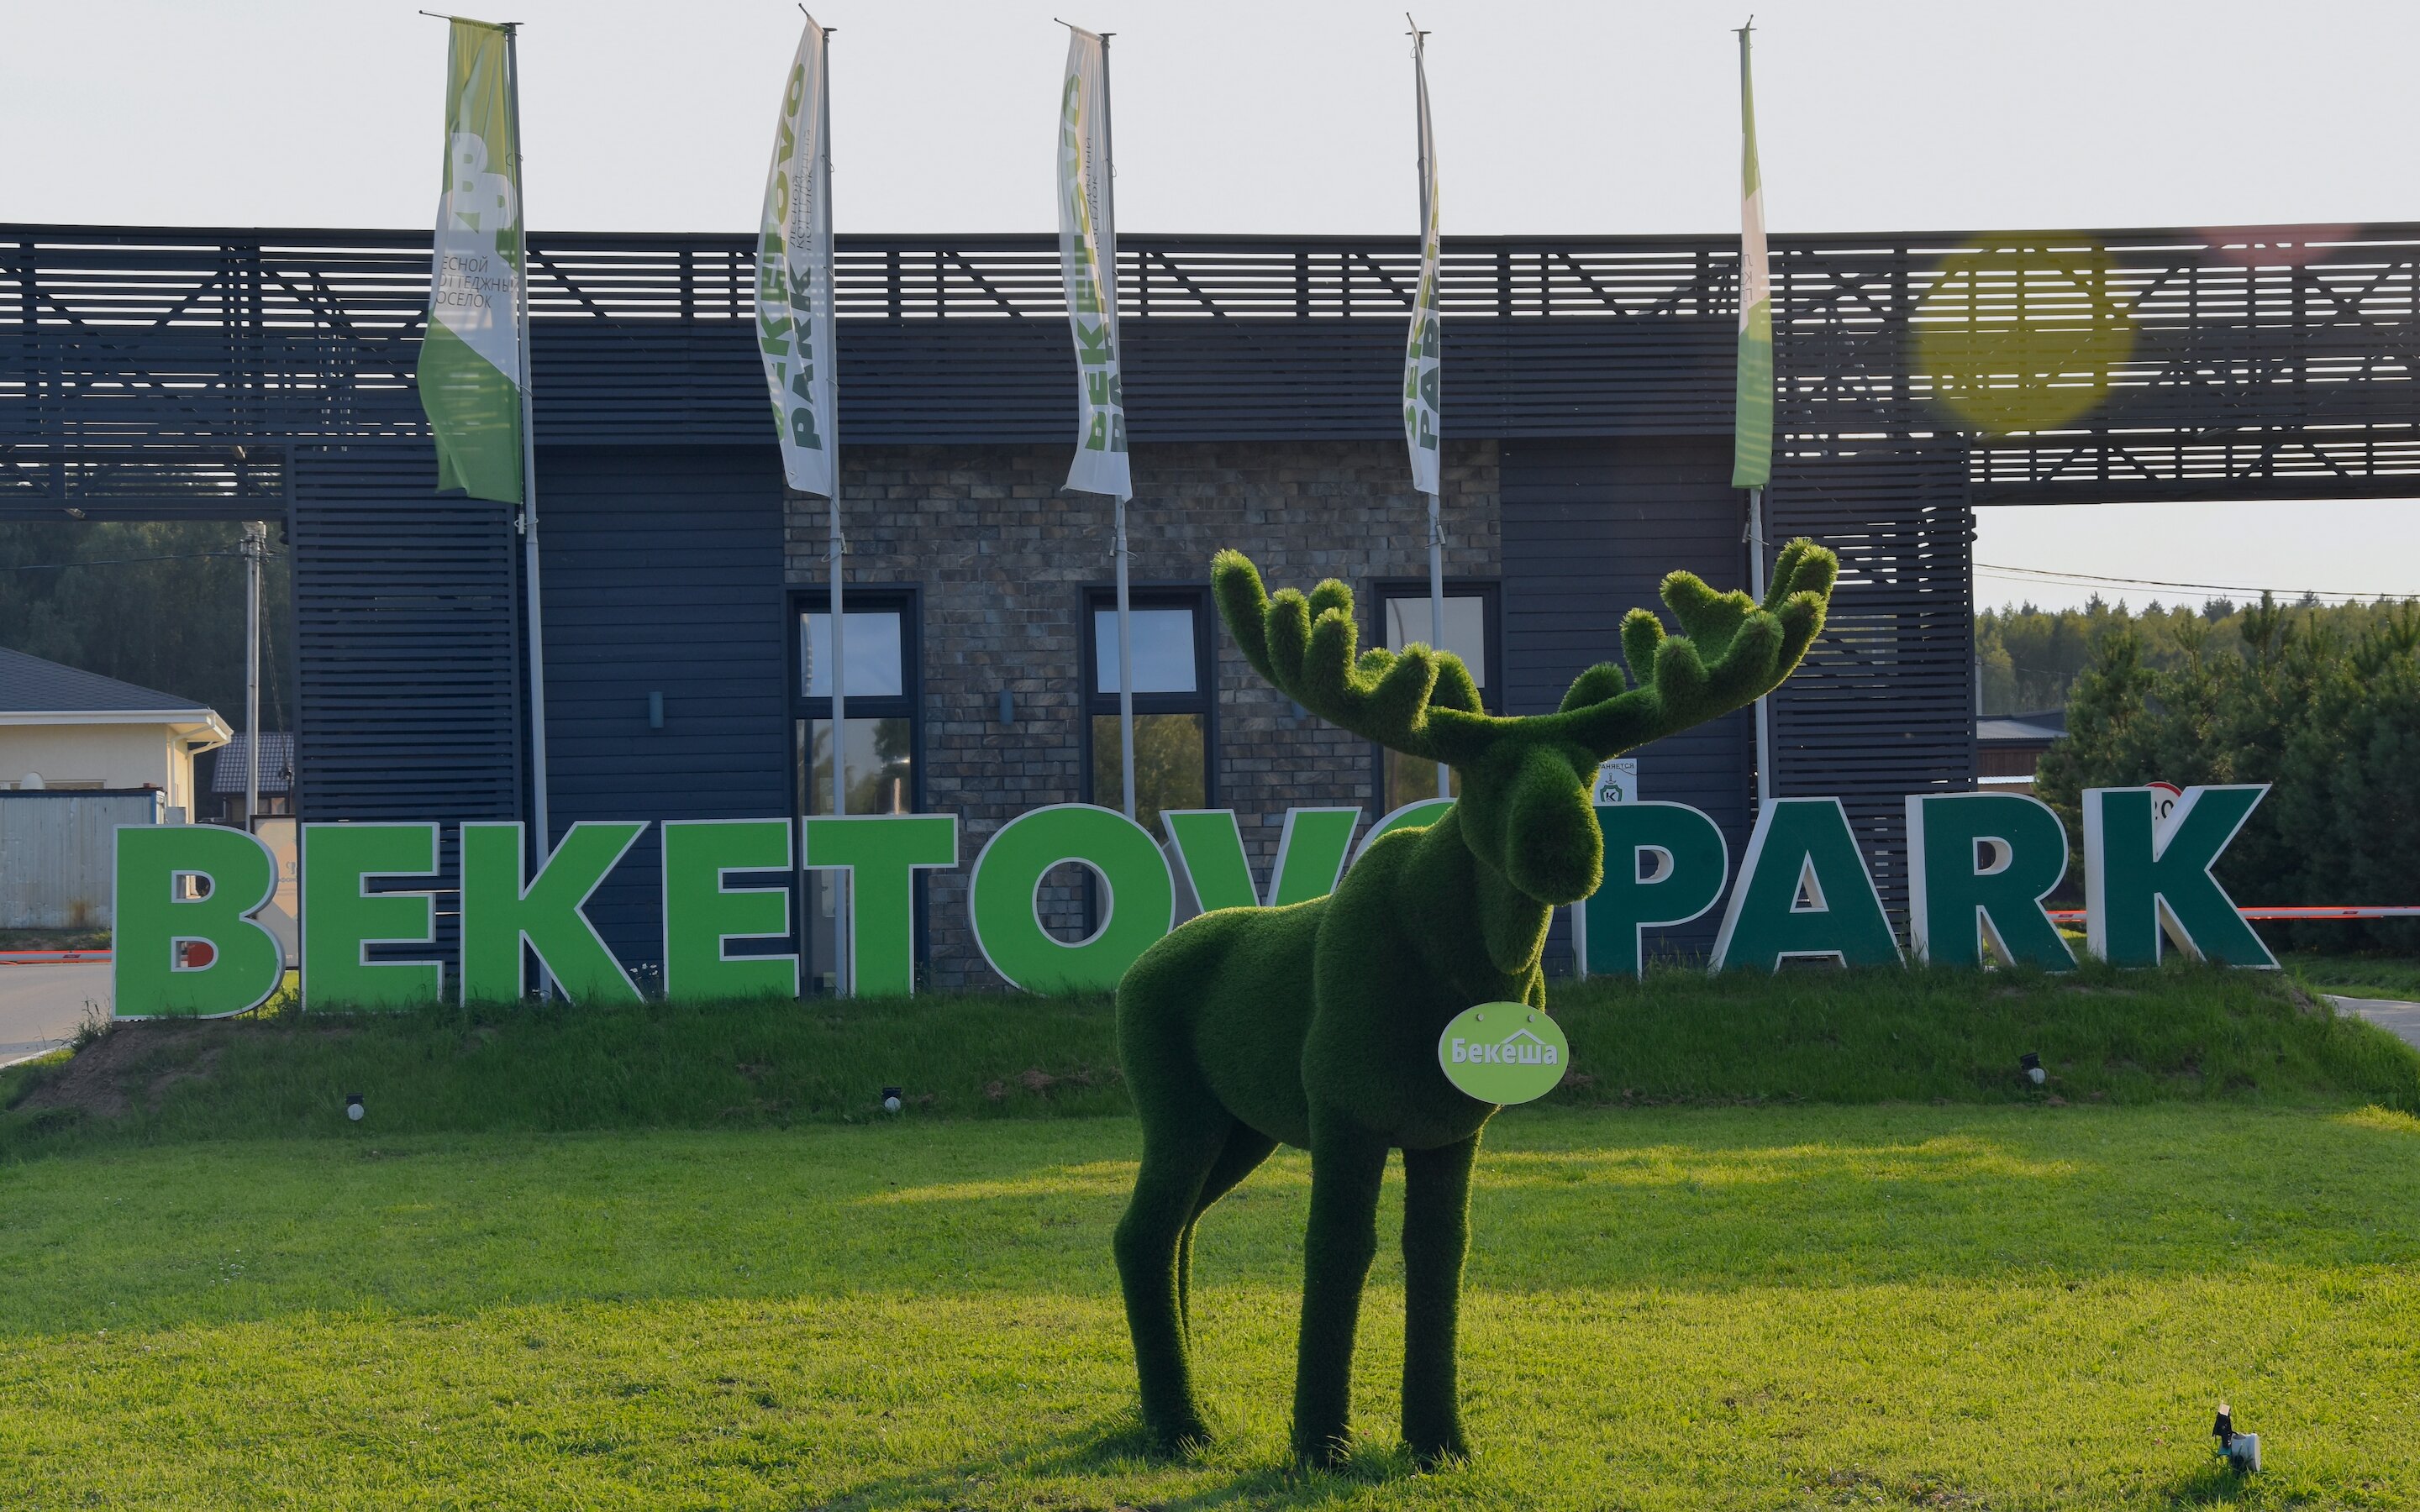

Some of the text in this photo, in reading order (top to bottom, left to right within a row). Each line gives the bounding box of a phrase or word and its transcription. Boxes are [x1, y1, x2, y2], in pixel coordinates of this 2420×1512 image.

[443, 255, 488, 273] ЕСНОЙ
[436, 289, 492, 308] ОСЁЛОК
[112, 782, 2282, 1021] BEKETOV PARK
[1451, 1037, 1559, 1065] Бекеша
